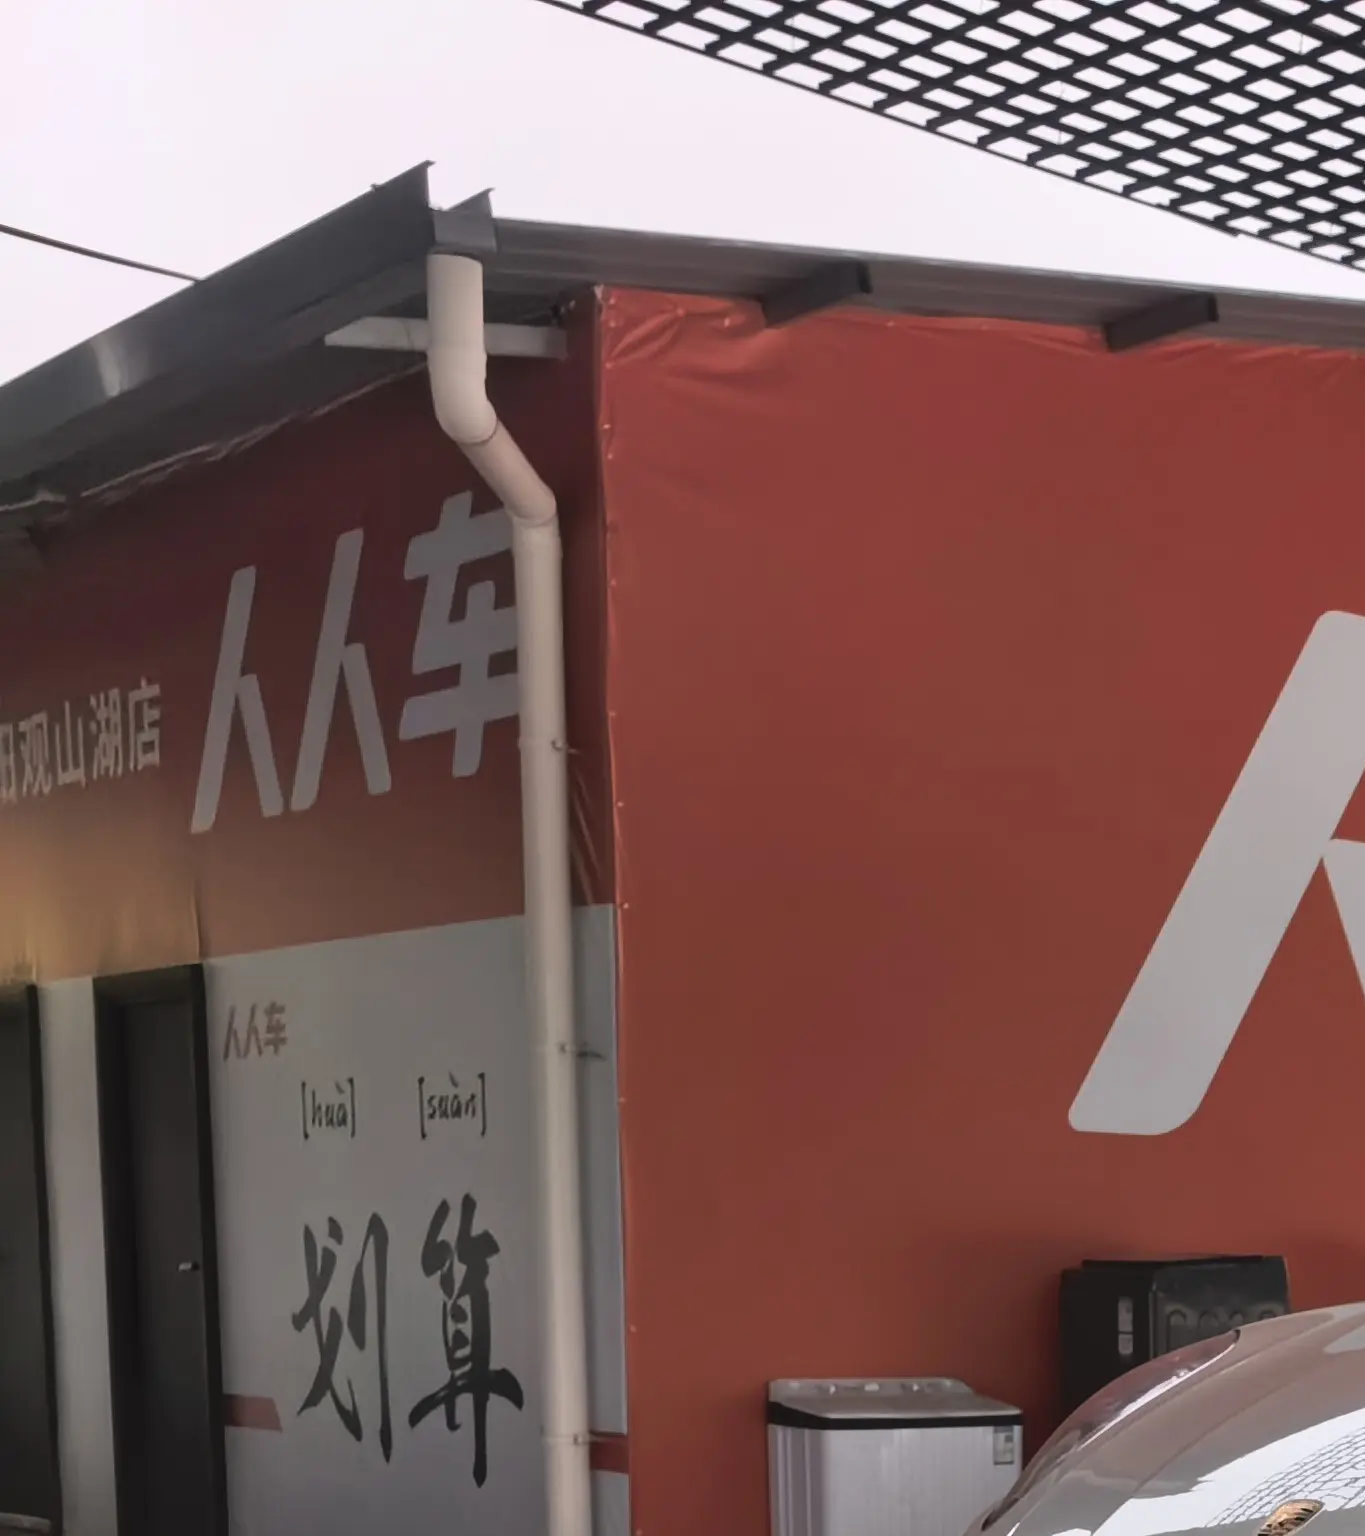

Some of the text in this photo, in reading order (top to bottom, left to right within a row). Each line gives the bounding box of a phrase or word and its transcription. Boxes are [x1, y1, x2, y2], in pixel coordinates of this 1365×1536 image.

[190, 490, 518, 834] 人人车
[223, 1002, 288, 1062] 人人车
